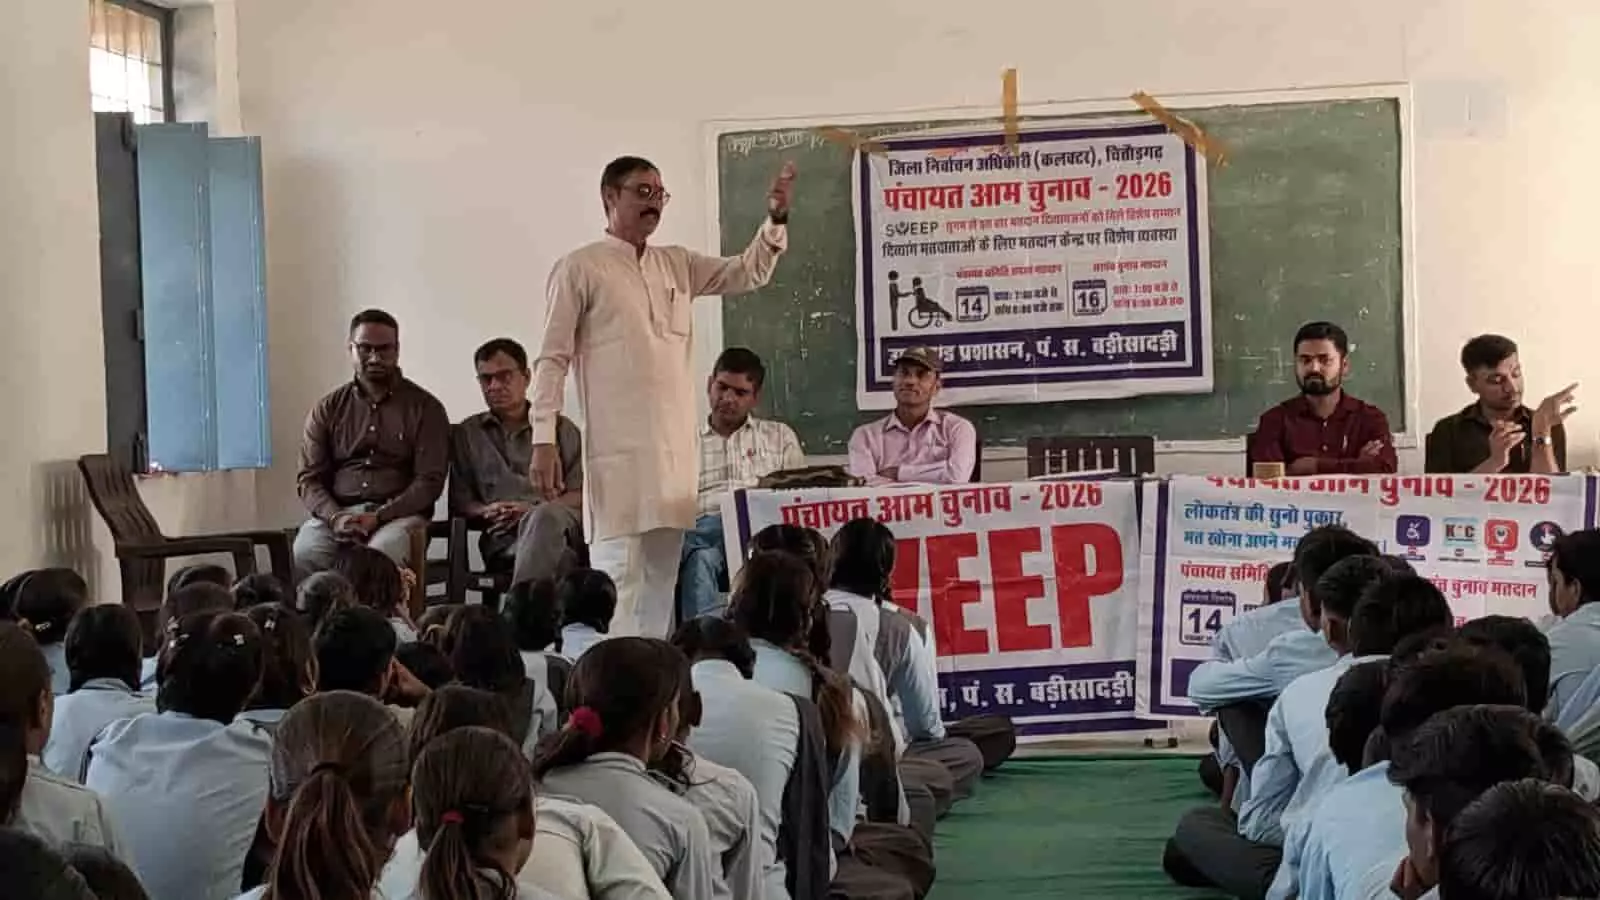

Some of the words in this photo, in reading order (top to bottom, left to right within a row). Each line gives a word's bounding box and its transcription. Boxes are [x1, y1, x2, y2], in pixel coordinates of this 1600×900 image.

[888, 158, 922, 177] जिला
[925, 155, 974, 173] निर्वाचन
[976, 151, 1031, 171] अधिकारी
[884, 181, 964, 211] पंचायत
[970, 182, 1024, 208] आम
[1027, 176, 1093, 213] चुनाव
[1116, 171, 1173, 200] 2026
[993, 234, 1016, 250] लिए
[1019, 235, 1056, 250] मतदान
[1086, 231, 1101, 245] पर
[1104, 228, 1134, 245] विशेष
[961, 297, 982, 315] 14
[1078, 291, 1100, 307] 16
[959, 341, 1031, 362] प्रशासन,
[1062, 338, 1087, 357] स.
[1484, 476, 1551, 505] 2026
[781, 497, 869, 528] पंचायत
[876, 493, 934, 523] आम
[940, 486, 1012, 527] चुनाव
[1040, 482, 1103, 511] 2026
[1244, 501, 1264, 521] की
[1269, 504, 1299, 529] सुनो
[1184, 530, 1203, 545] मत
[1208, 528, 1242, 547] खोना
[1181, 560, 1226, 579] पंचायत
[889, 522, 1124, 658] EEP
[1188, 607, 1223, 634] 14
[993, 683, 1024, 705] स.
[1028, 671, 1135, 709] बड़ीसादड़ी
